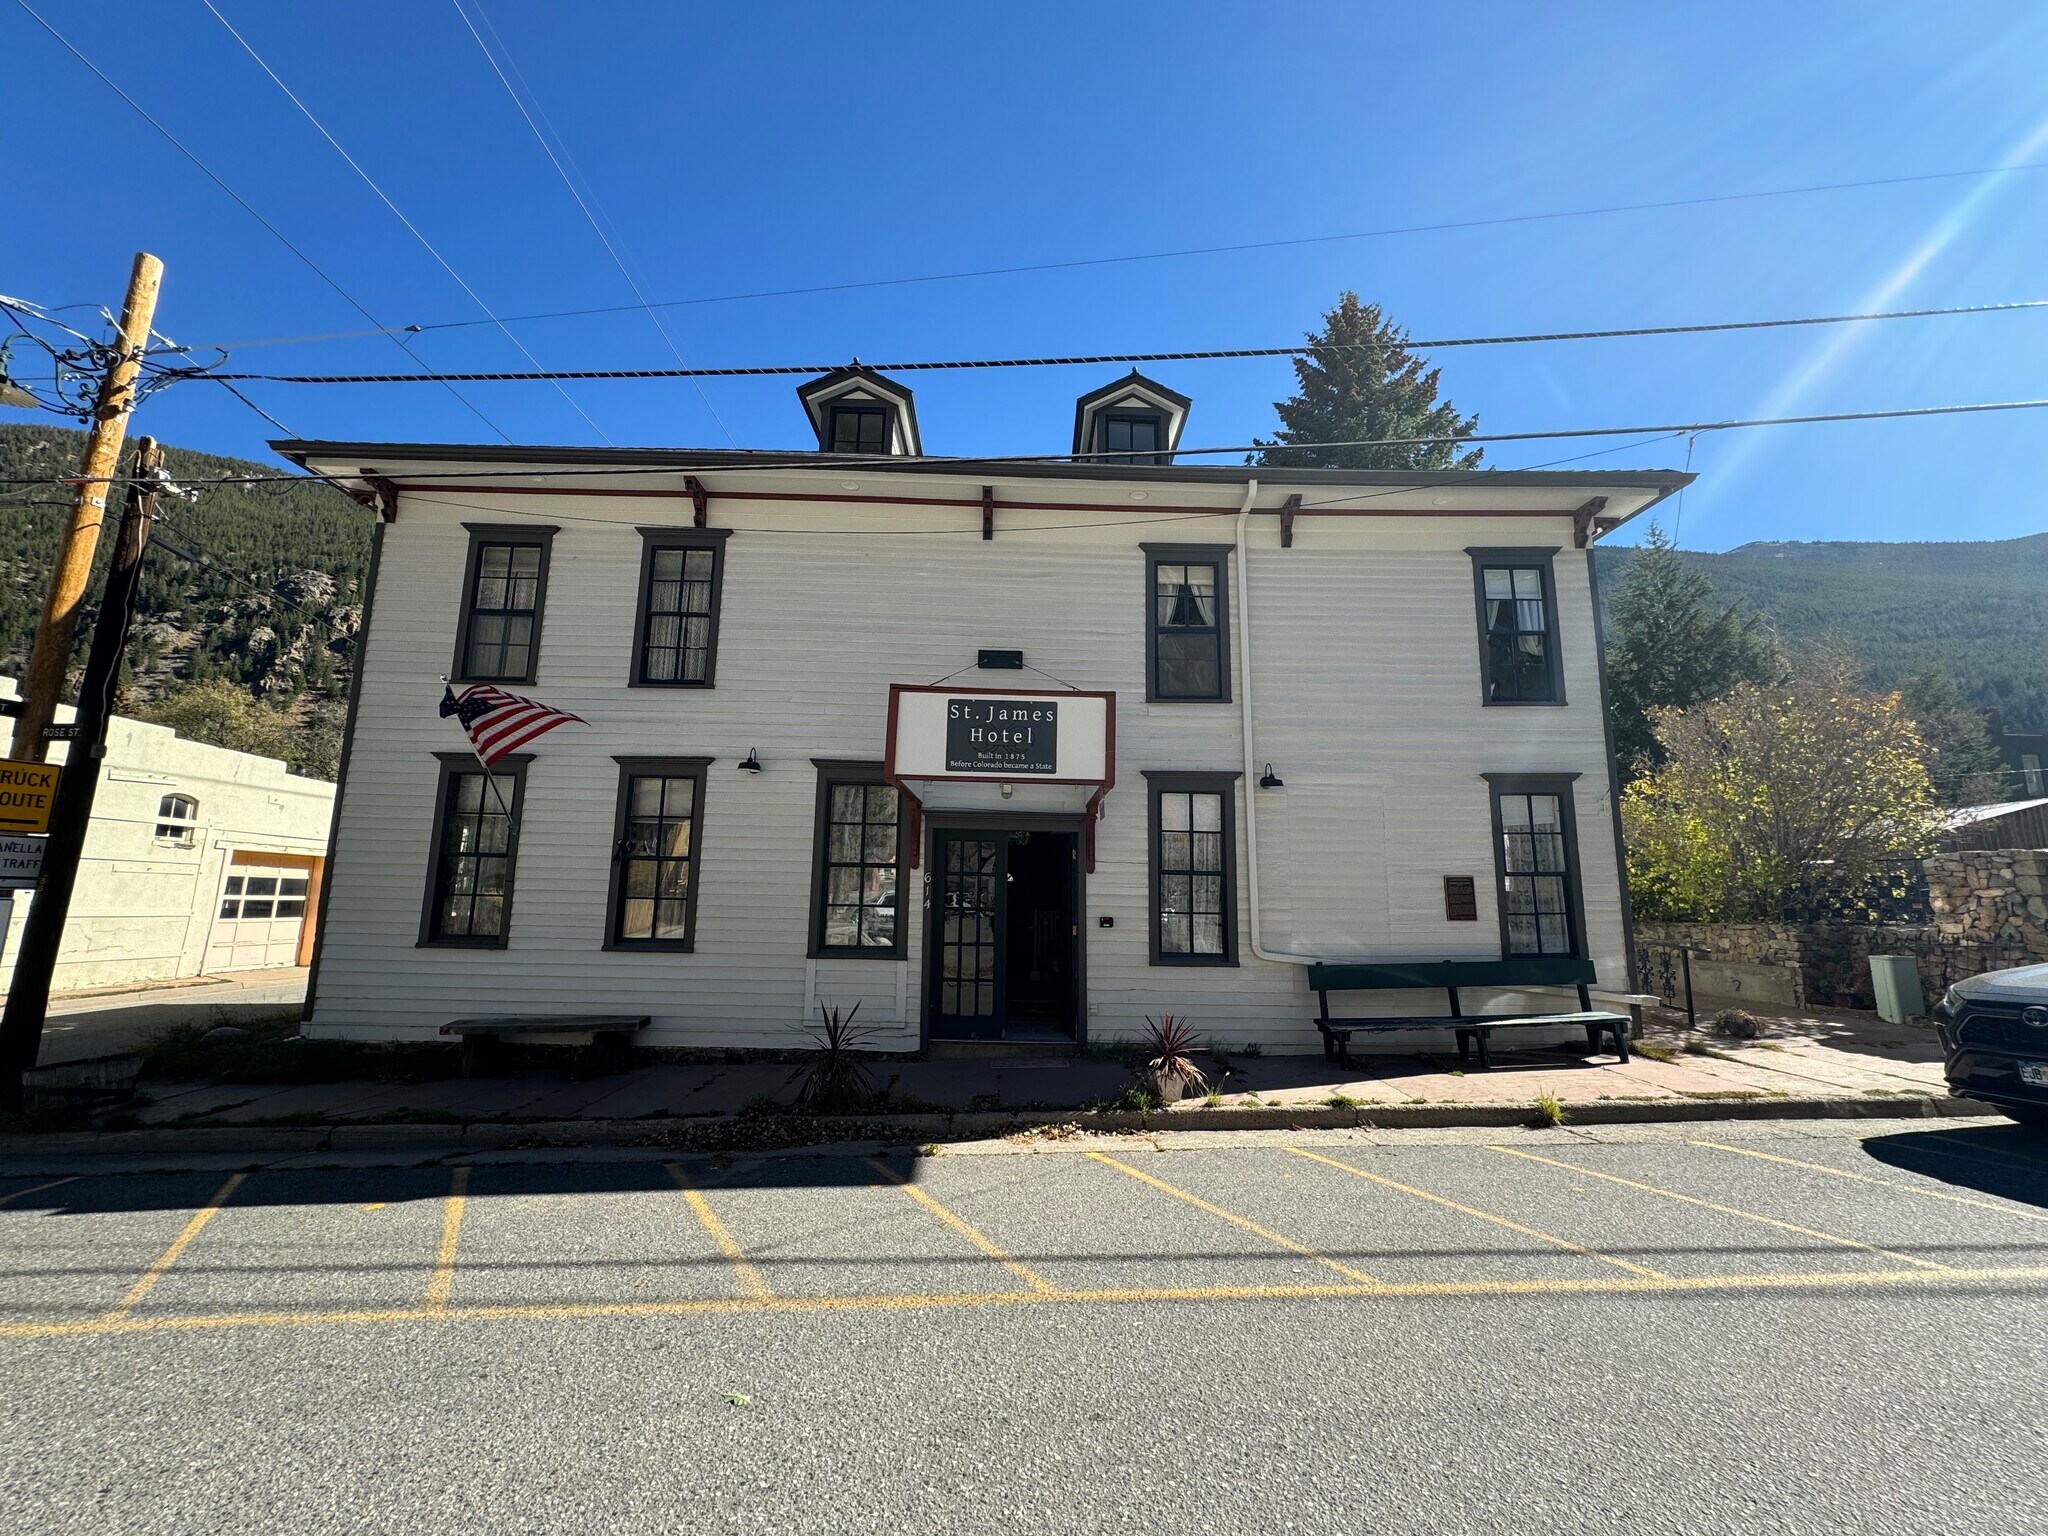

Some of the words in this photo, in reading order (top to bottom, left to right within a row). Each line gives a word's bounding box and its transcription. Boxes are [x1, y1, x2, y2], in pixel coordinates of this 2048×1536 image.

[950, 704, 979, 719] St.
[986, 706, 1054, 723] James
[42, 727, 66, 737] ROSE
[970, 727, 1033, 744] Hotel
[978, 752, 994, 760] Built
[973, 761, 1003, 769] Colorado
[1003, 762, 1028, 770] became
[1035, 762, 1052, 770] State
[0, 769, 52, 788] RUCK
